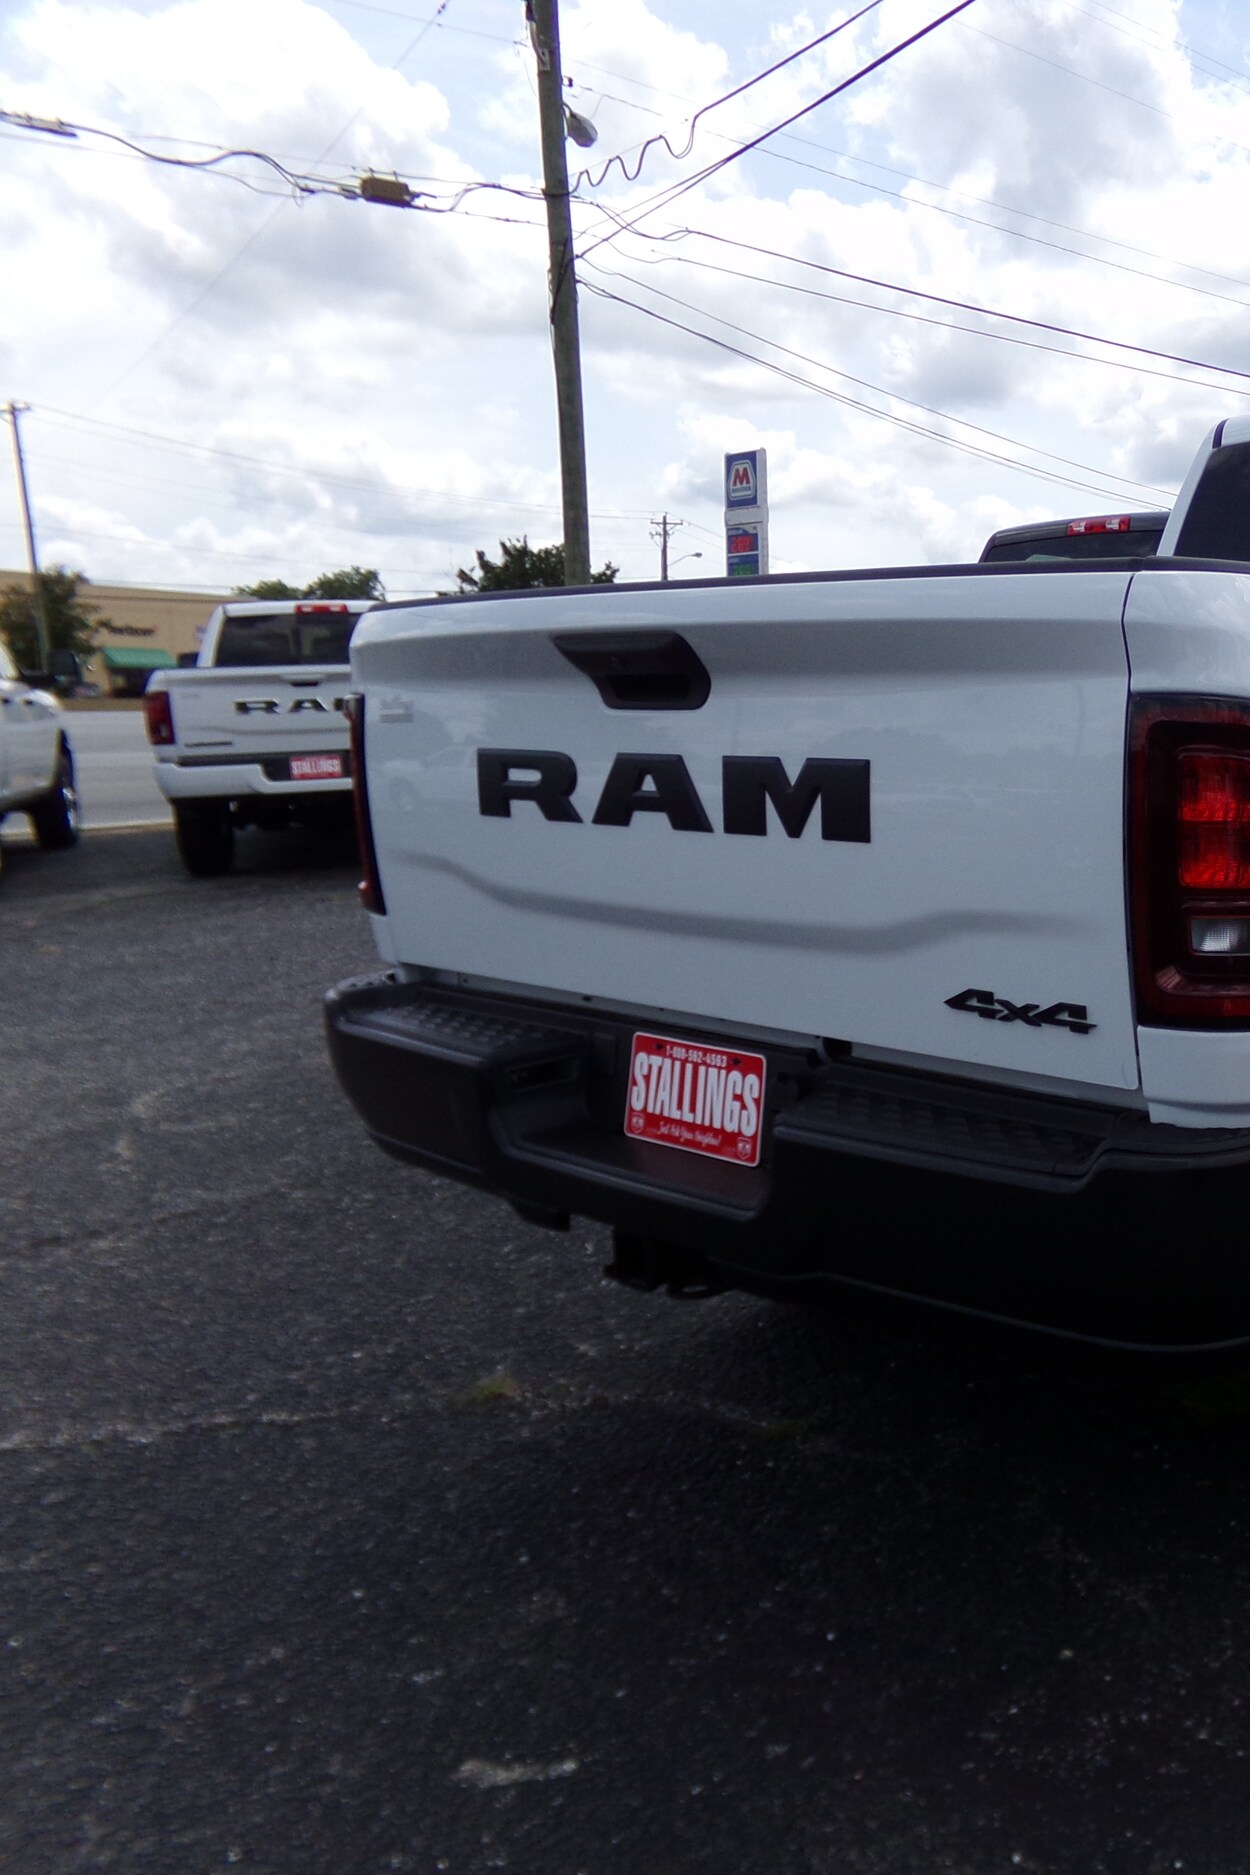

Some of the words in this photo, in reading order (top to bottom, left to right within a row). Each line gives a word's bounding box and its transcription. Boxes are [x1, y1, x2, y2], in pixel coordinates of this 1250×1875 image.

[732, 467, 751, 486] M
[234, 697, 345, 715] RA
[291, 758, 340, 774] STALLINGS
[477, 747, 871, 843] RAM
[630, 1052, 760, 1137] STALLINGS
